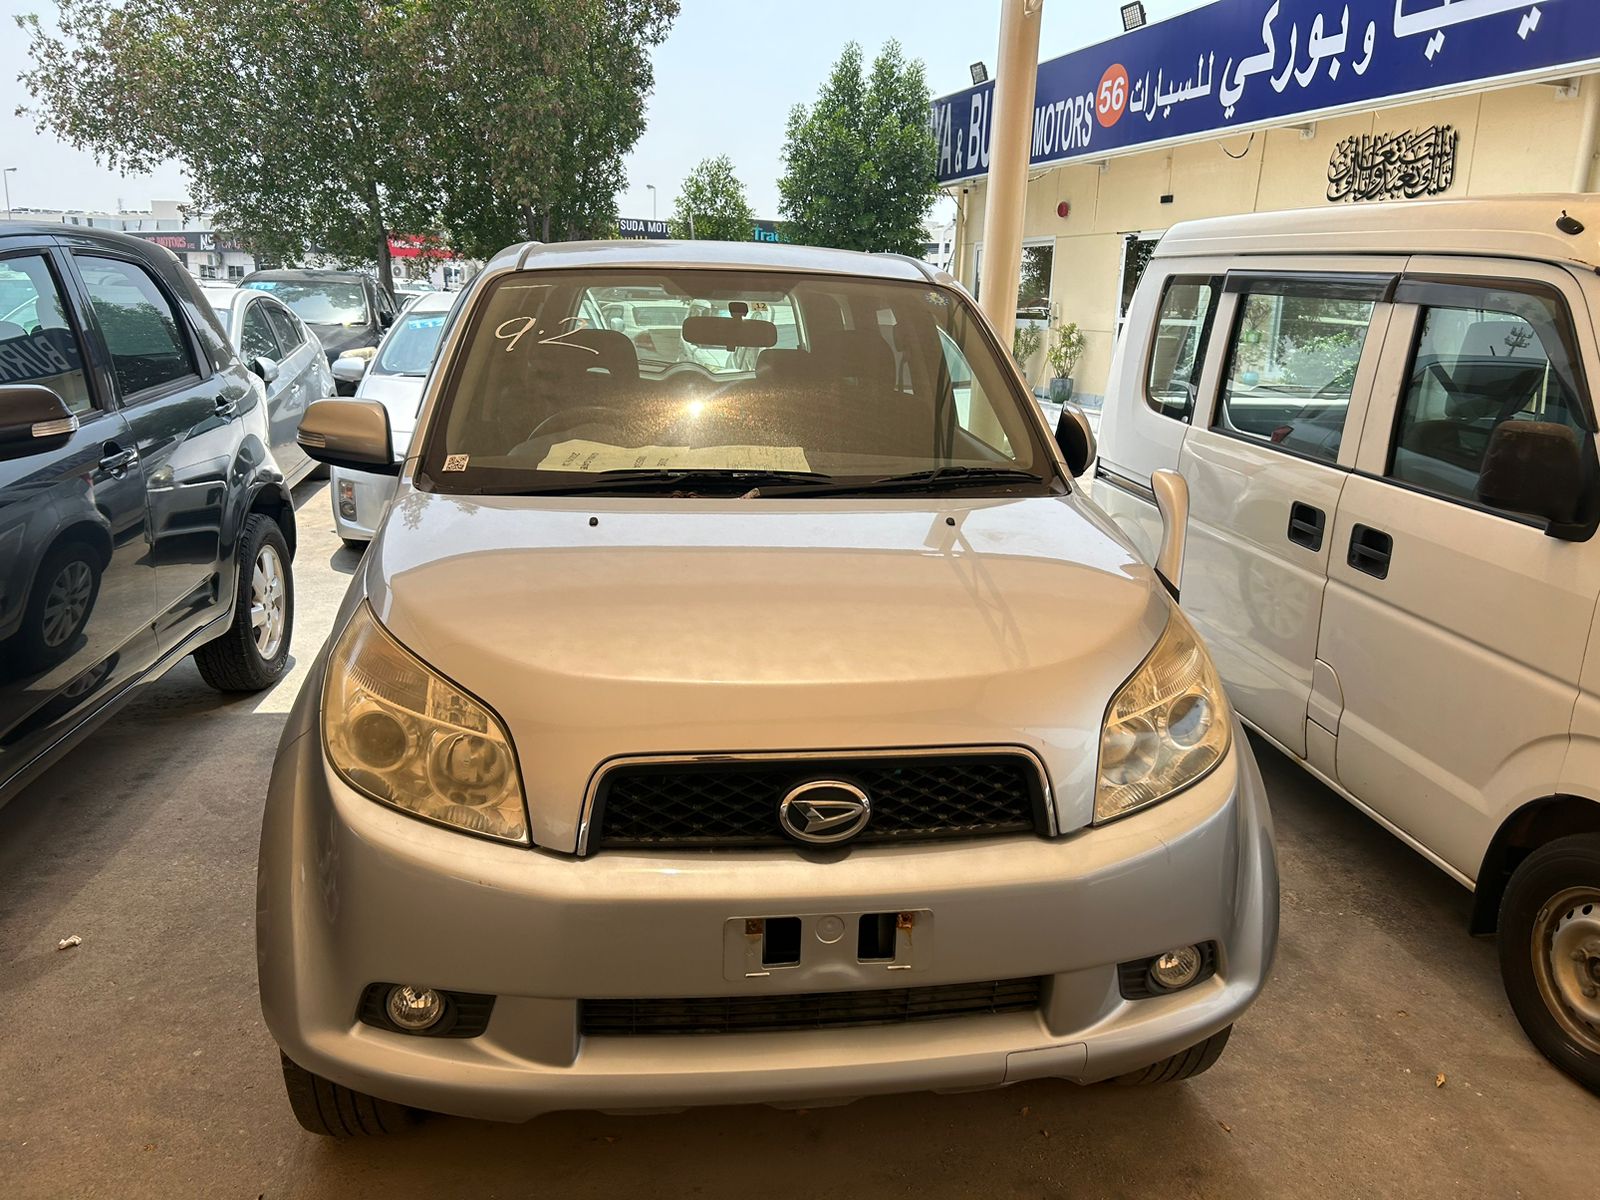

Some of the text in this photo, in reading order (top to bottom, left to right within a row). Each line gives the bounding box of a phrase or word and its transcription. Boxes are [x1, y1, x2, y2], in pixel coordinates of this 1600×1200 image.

[954, 128, 963, 173] &
[1031, 92, 1094, 157] MOTORS
[1099, 76, 1125, 114] 56
[1129, 51, 1215, 121] للسيارات
